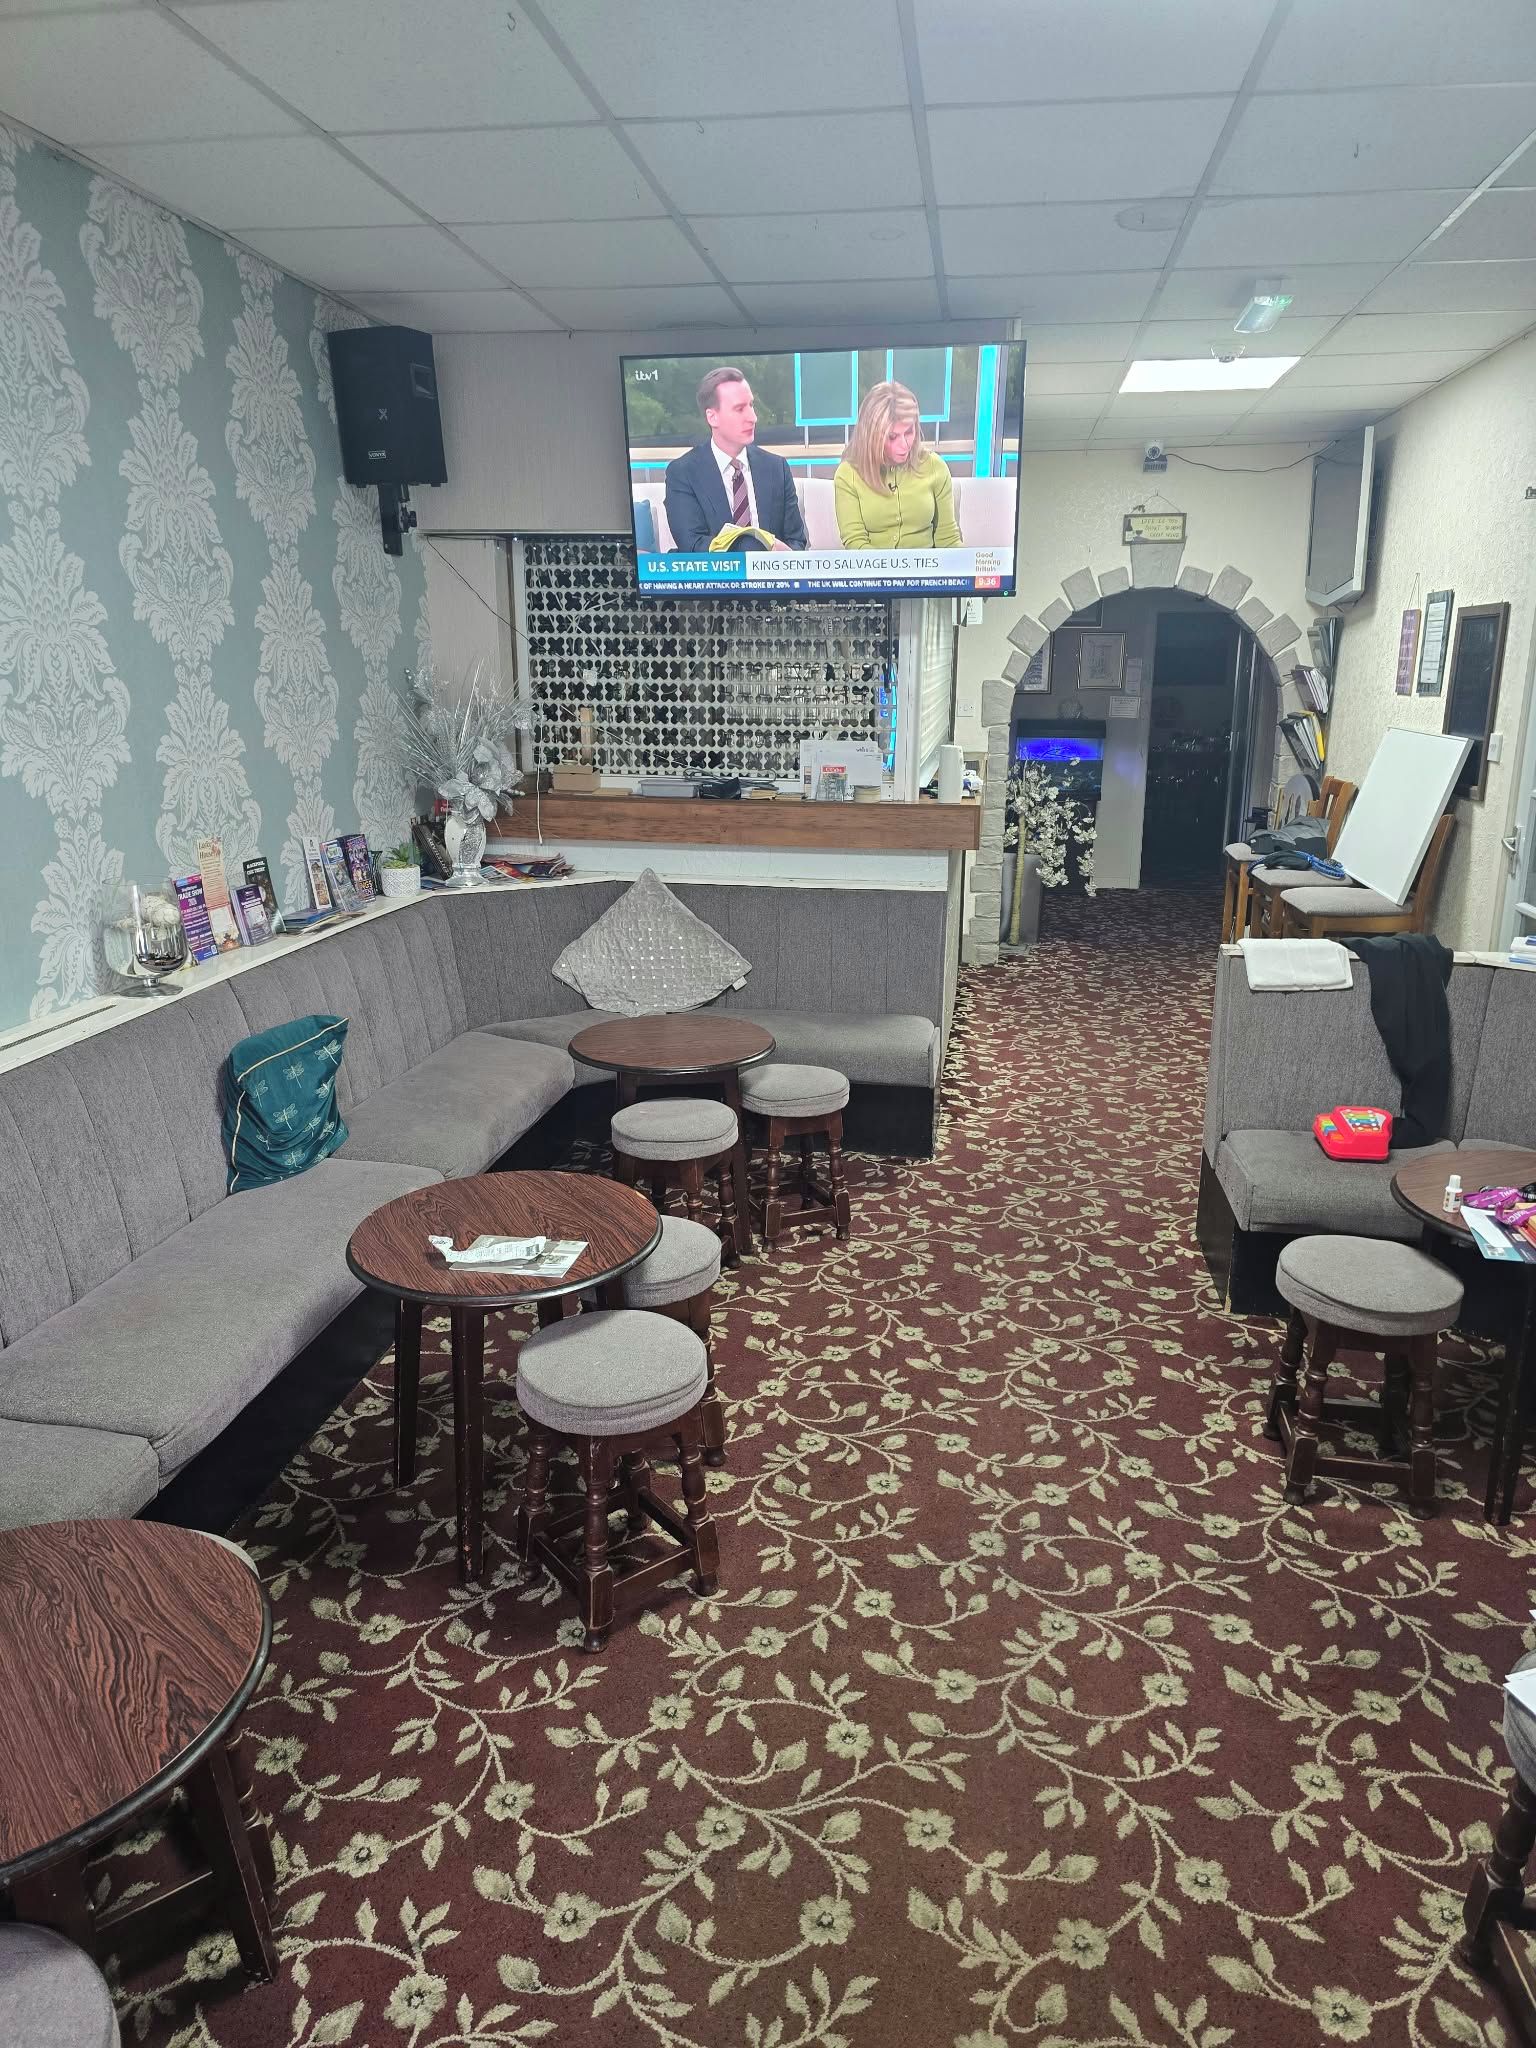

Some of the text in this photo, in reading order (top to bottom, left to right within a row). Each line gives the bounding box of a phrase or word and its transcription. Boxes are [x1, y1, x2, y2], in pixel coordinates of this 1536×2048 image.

[635, 369, 658, 381] itv1
[648, 560, 741, 573] U.S. STATE VISIT
[752, 557, 939, 571] KING SENT TO SALVAGE U.S. TIES
[653, 582, 677, 590] HAVING
[705, 581, 730, 589] ATTACK
[740, 581, 766, 589] STROKE
[766, 581, 775, 589] BY
[775, 581, 790, 589] 20%
[832, 580, 848, 588] WILL
[892, 579, 906, 587] PAY
[907, 579, 919, 587] FOR
[920, 578, 947, 586] FRENCH
